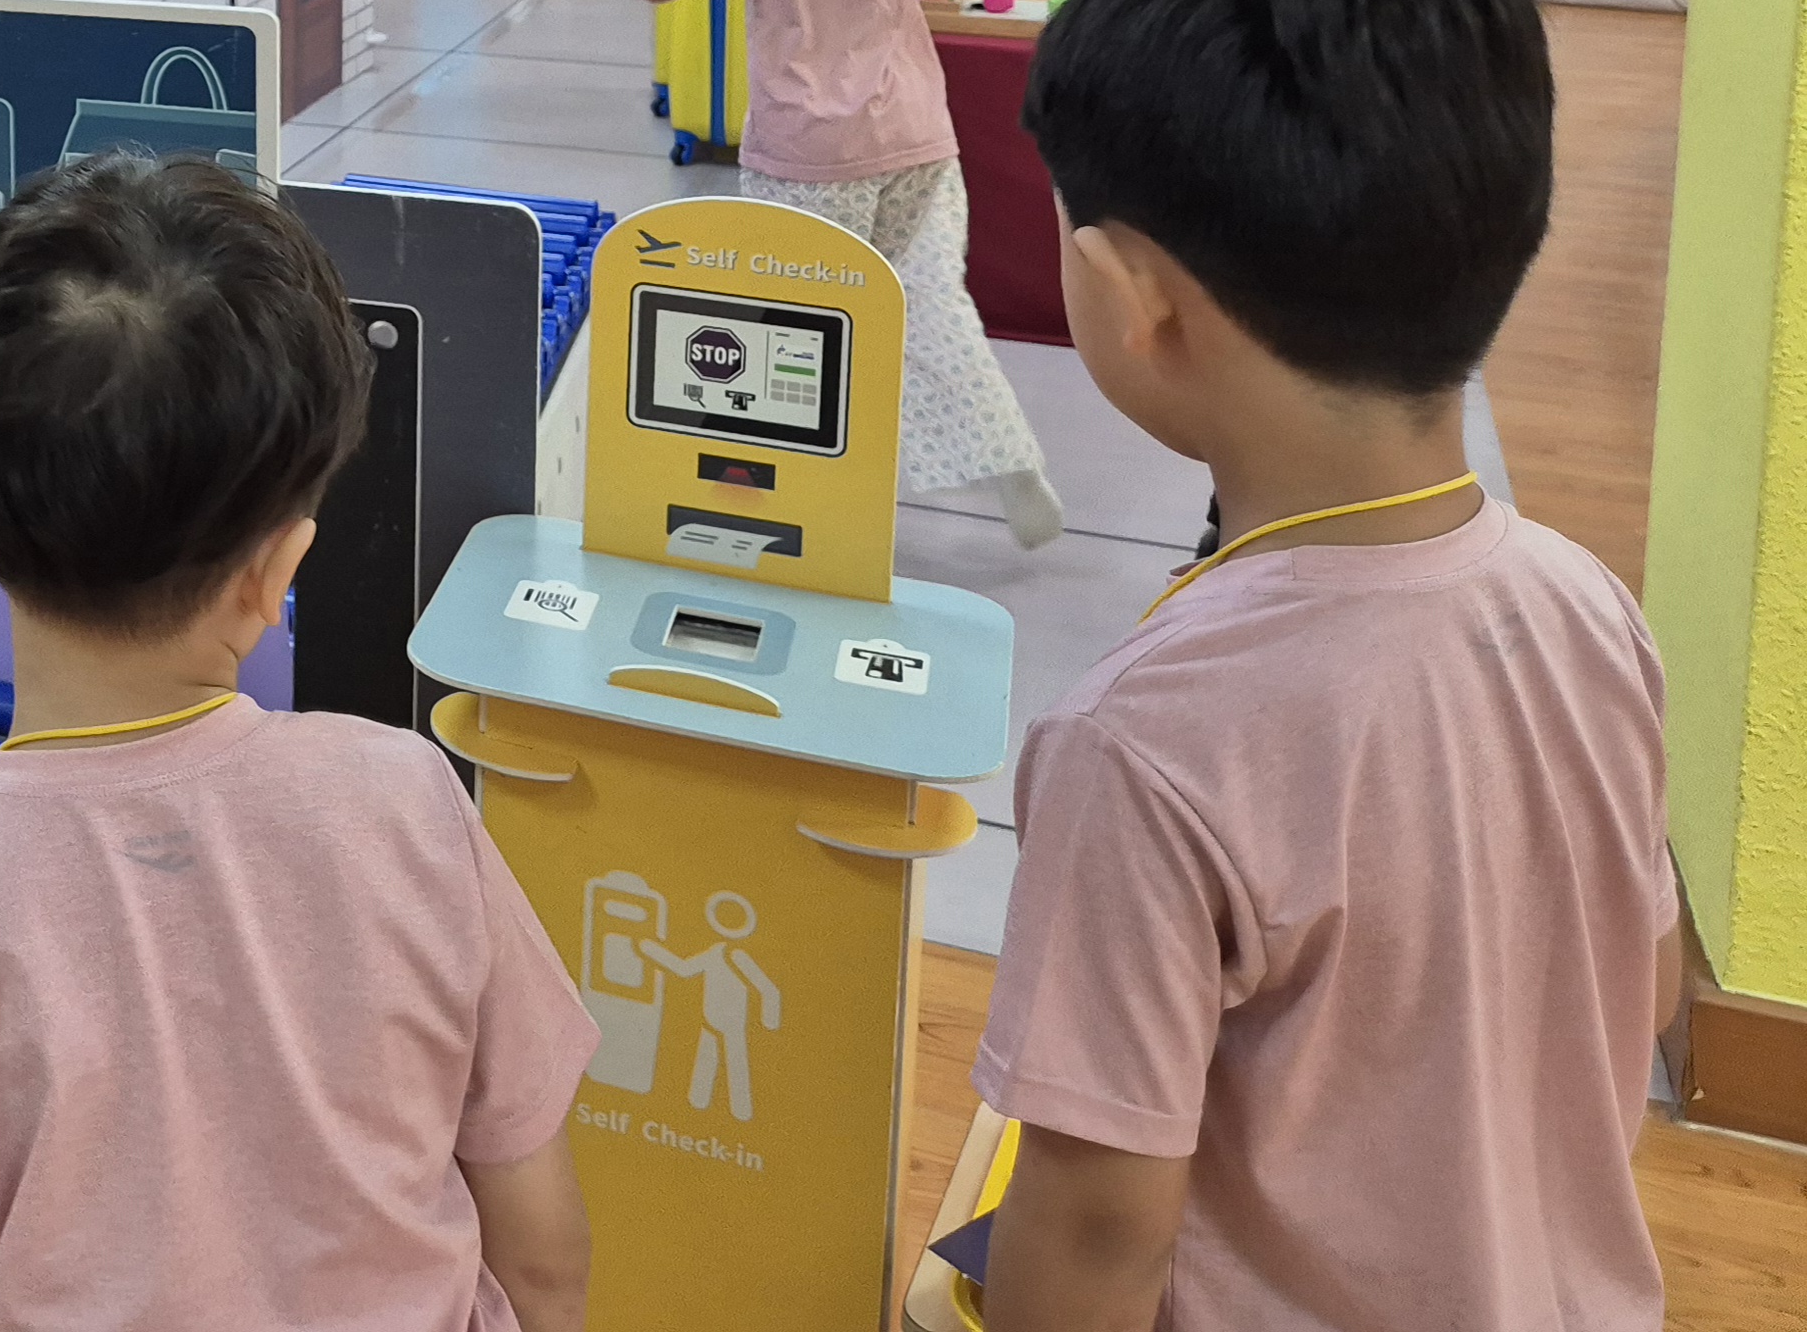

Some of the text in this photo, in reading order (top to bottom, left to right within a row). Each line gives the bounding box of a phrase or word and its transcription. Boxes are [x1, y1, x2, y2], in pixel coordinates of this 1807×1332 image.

[686, 245, 866, 288] Self Check-in
[691, 343, 741, 367] STOP
[575, 1102, 765, 1171] Self Check-in
